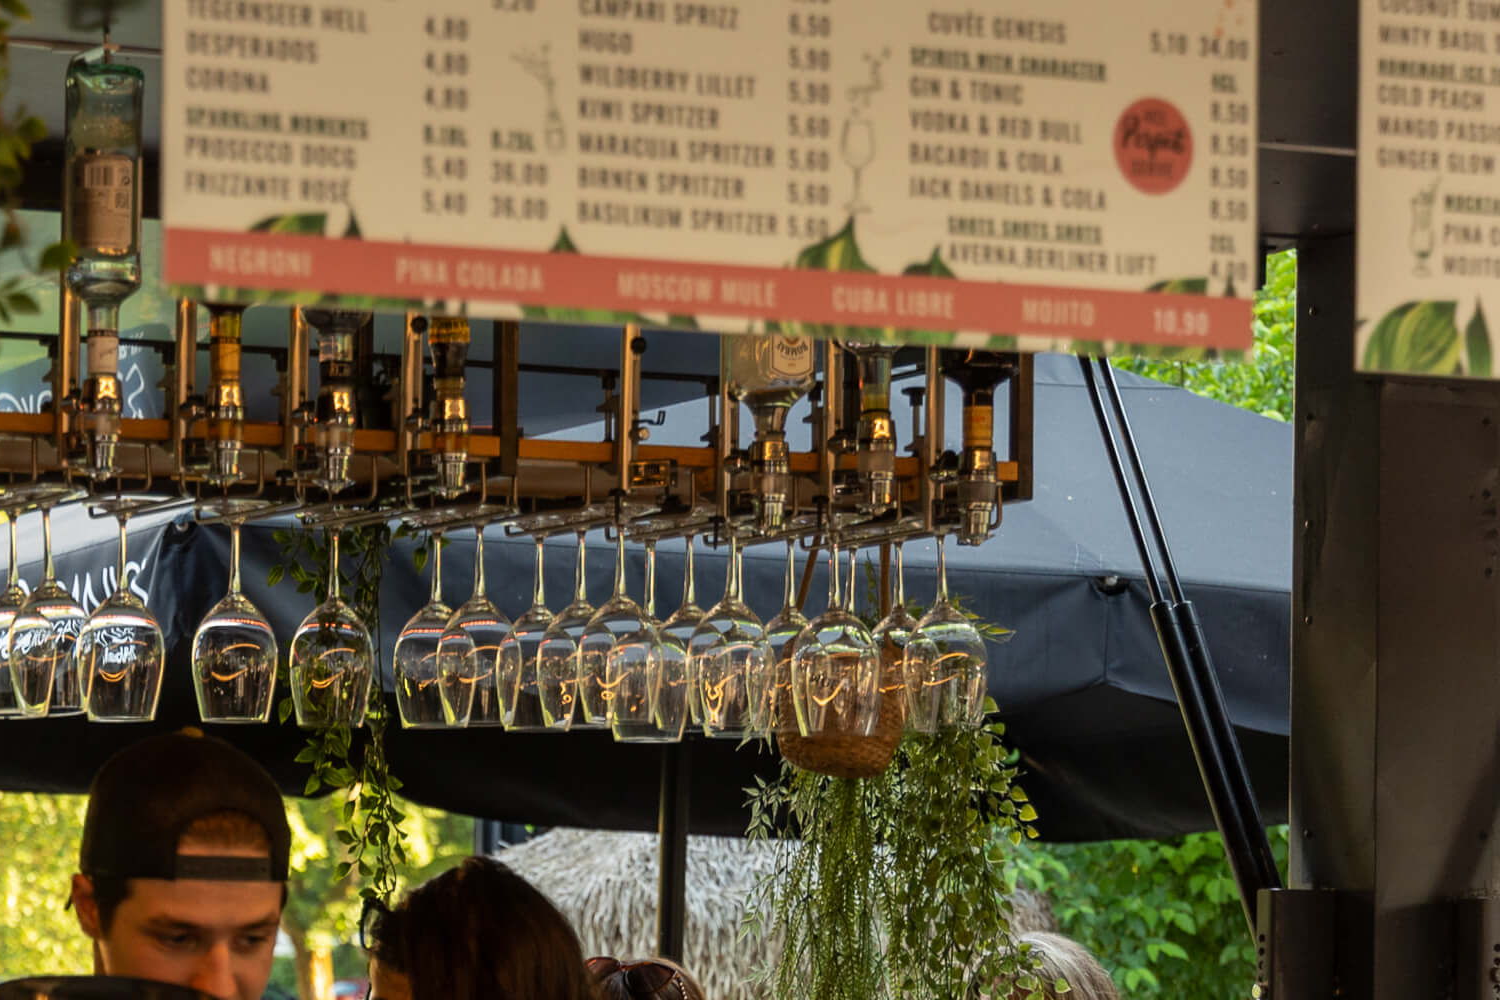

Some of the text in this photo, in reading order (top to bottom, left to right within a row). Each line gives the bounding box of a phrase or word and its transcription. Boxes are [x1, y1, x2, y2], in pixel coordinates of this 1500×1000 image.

[186, 0, 314, 28] TEGERNSEER
[320, 7, 368, 34] HELL
[579, 0, 665, 24] CAMPARI
[186, 29, 320, 64] DESPERADOS
[579, 29, 634, 55] HUGO
[993, 17, 1067, 45] GENESIS
[1378, 23, 1431, 47] MINTY
[1438, 28, 1487, 54] BASIL
[185, 65, 270, 94] CORONA
[579, 63, 688, 92] WILDBERRY
[695, 71, 757, 100] LILLET
[909, 75, 940, 98] GIN
[949, 78, 961, 101] &
[970, 80, 1024, 107] TONIC
[578, 96, 623, 121] KIWI
[631, 101, 720, 130] SPRITZER
[1377, 83, 1485, 112] COLD PEACH
[289, 114, 369, 139] MOMENTS
[909, 108, 969, 134] VODKA
[997, 116, 1033, 141] RED
[1040, 119, 1083, 146] BULL
[1377, 114, 1439, 140] MANGO
[185, 135, 293, 163] PROSECCO
[687, 140, 776, 169] SPRITZER
[909, 141, 989, 169] BACARDI
[1017, 151, 1063, 176] COLA
[184, 170, 290, 201] FRIZZANTE
[579, 166, 648, 194] BIRNEN
[656, 171, 745, 200] SPRITZER
[909, 175, 952, 200] JACK
[959, 179, 1034, 207] DANIELS
[1061, 187, 1106, 212] COLA
[579, 199, 683, 229] BASILIKUM
[690, 206, 779, 236] SPRITZER
[1116, 252, 1157, 277] LUFT
[207, 244, 313, 278] NEGRONI
[395, 256, 448, 285] PINA
[455, 261, 545, 291] COLADA
[616, 271, 713, 304] MOSCOW
[719, 278, 778, 309] MULE
[831, 285, 889, 315] CUBA
[894, 289, 956, 320] LIBRE
[1022, 296, 1095, 327] MOJITO
